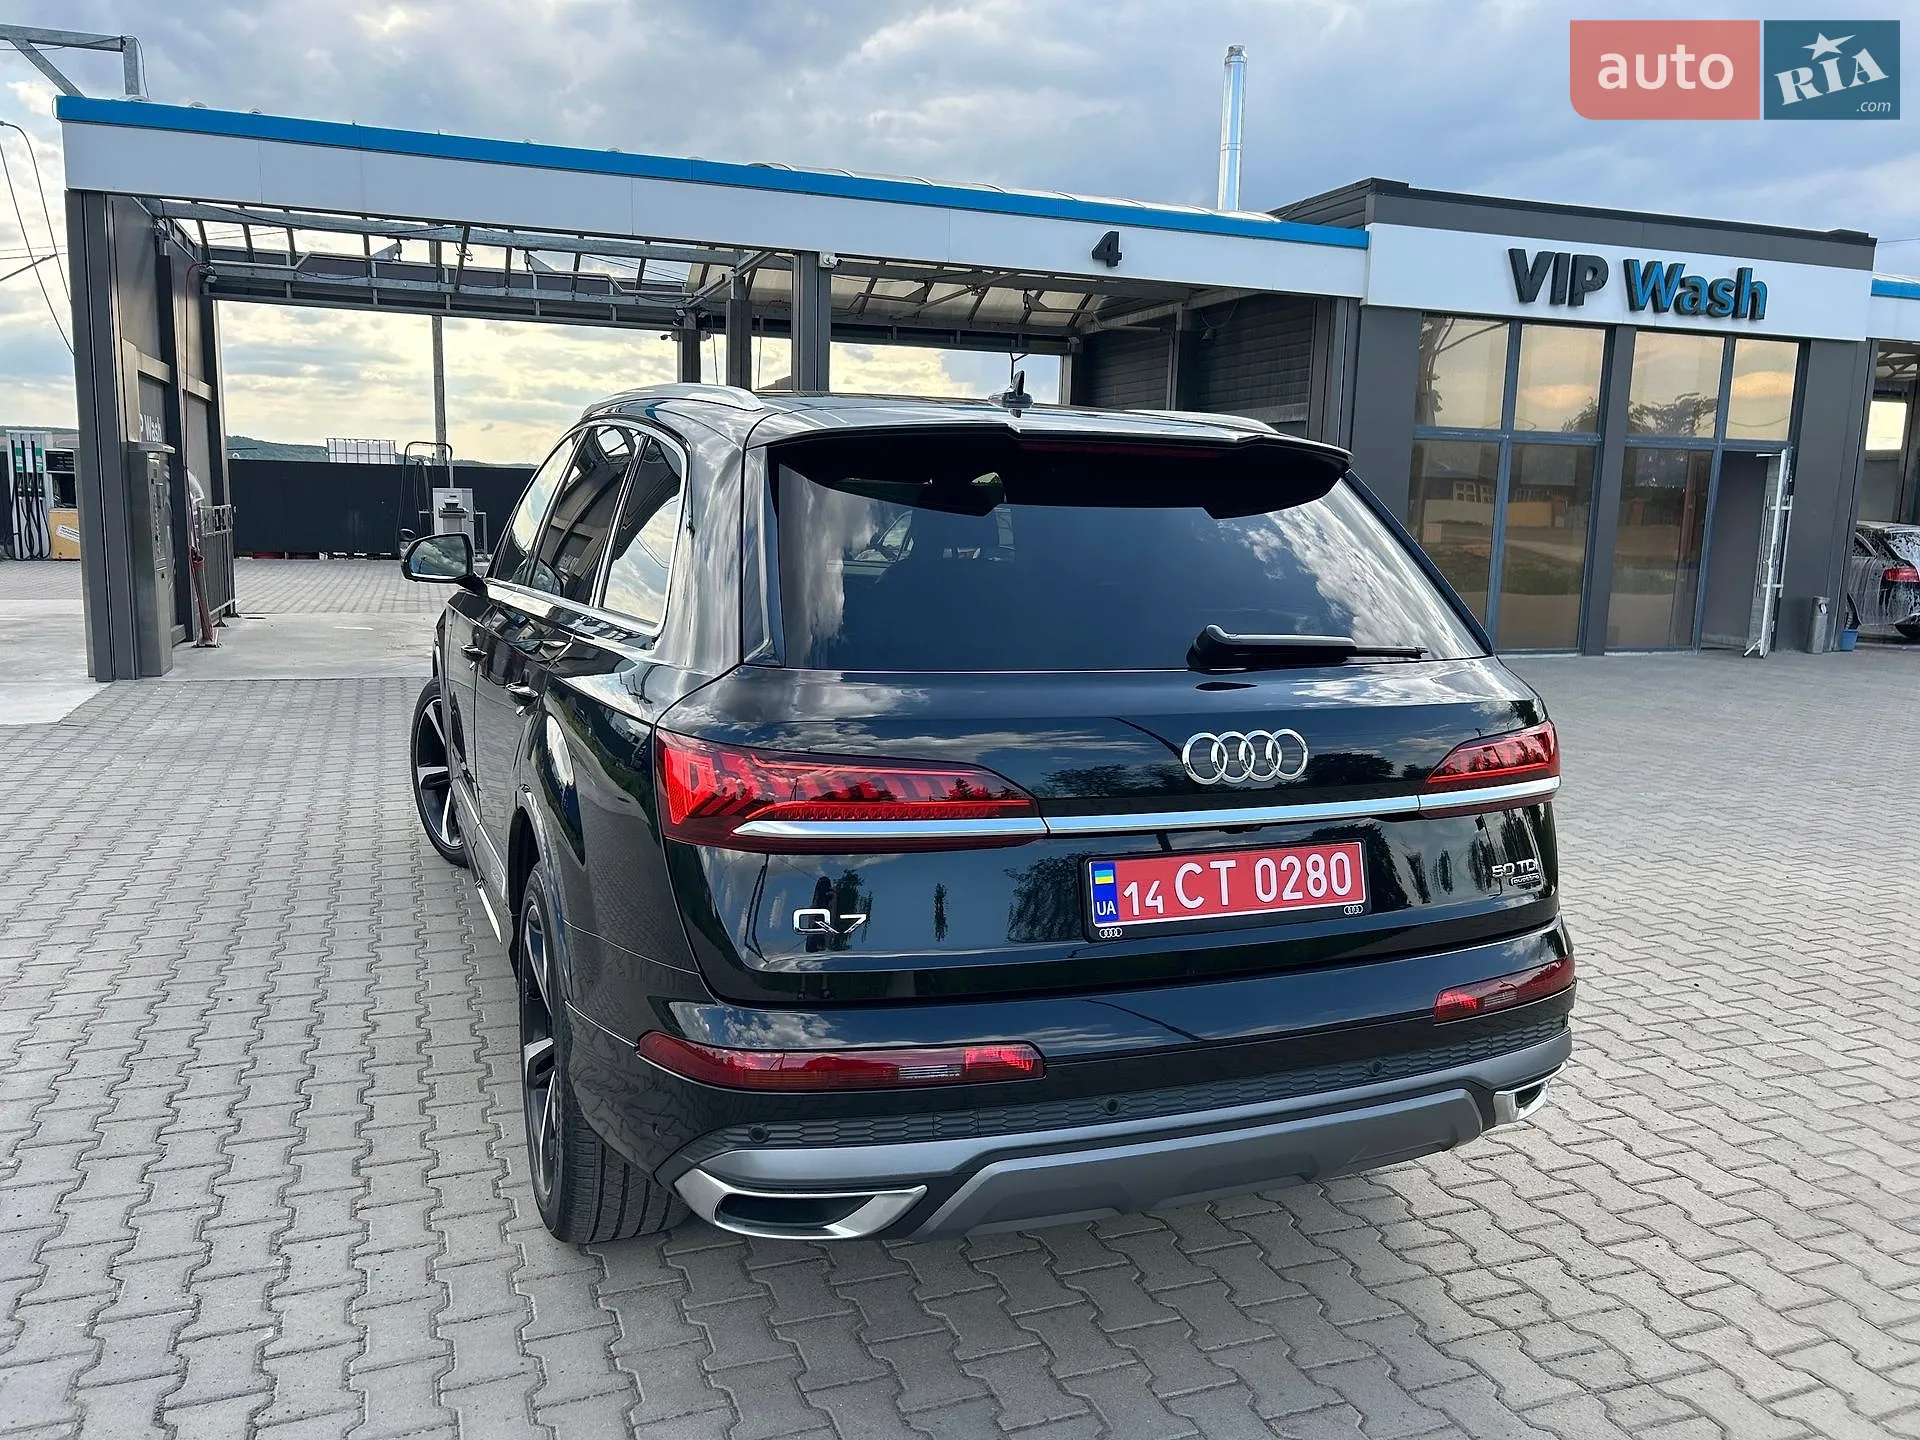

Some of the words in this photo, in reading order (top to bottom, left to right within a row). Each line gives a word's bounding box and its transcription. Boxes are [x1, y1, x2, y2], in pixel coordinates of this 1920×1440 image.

[1092, 230, 1122, 268] 4
[1508, 248, 1609, 306] VIP
[1623, 258, 1768, 320] Wash
[1122, 880, 1164, 916] 14
[1174, 859, 1237, 909] CT
[1254, 851, 1352, 903] 0280
[1491, 862, 1515, 877] 50
[793, 908, 867, 934] Q7
[1096, 901, 1117, 916] UA
